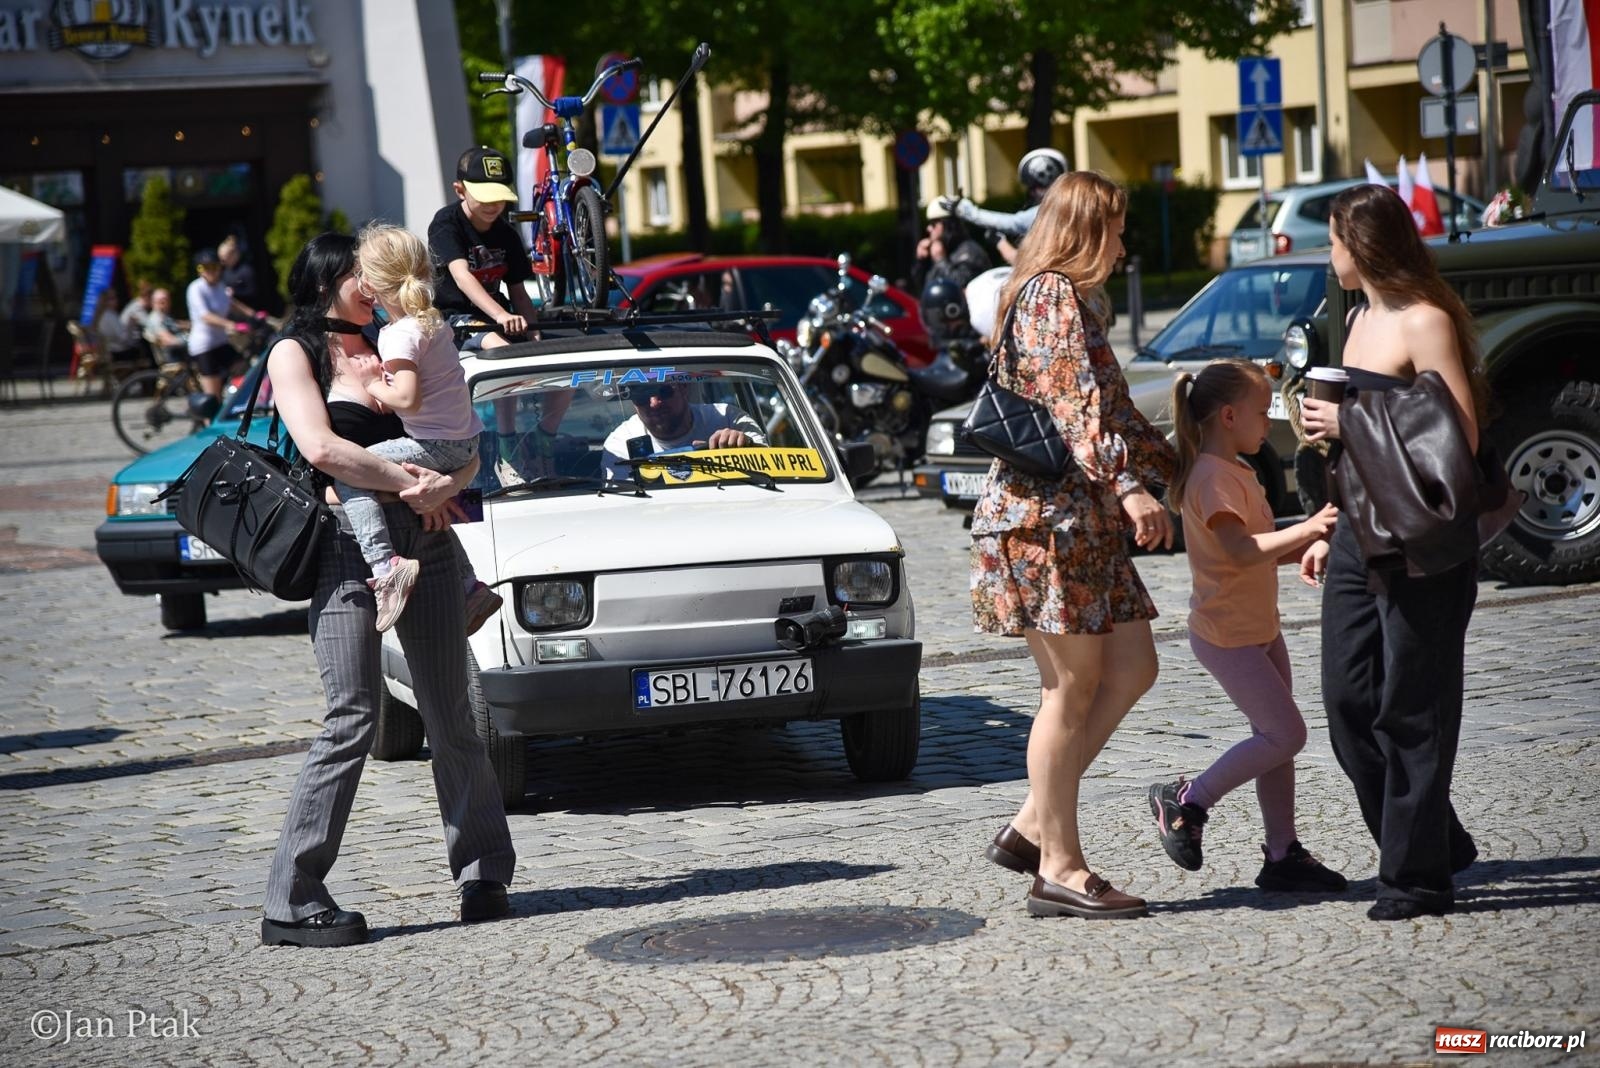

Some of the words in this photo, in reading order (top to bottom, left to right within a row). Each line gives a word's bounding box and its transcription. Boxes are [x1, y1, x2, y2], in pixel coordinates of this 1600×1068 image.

[163, 0, 316, 58] Rynek
[569, 366, 676, 389] FIAT
[768, 453, 787, 471] W
[786, 453, 818, 472] PRL
[191, 538, 219, 559] SR
[652, 672, 710, 705] SBL
[719, 662, 809, 700] 76126
[638, 696, 650, 704] PL
